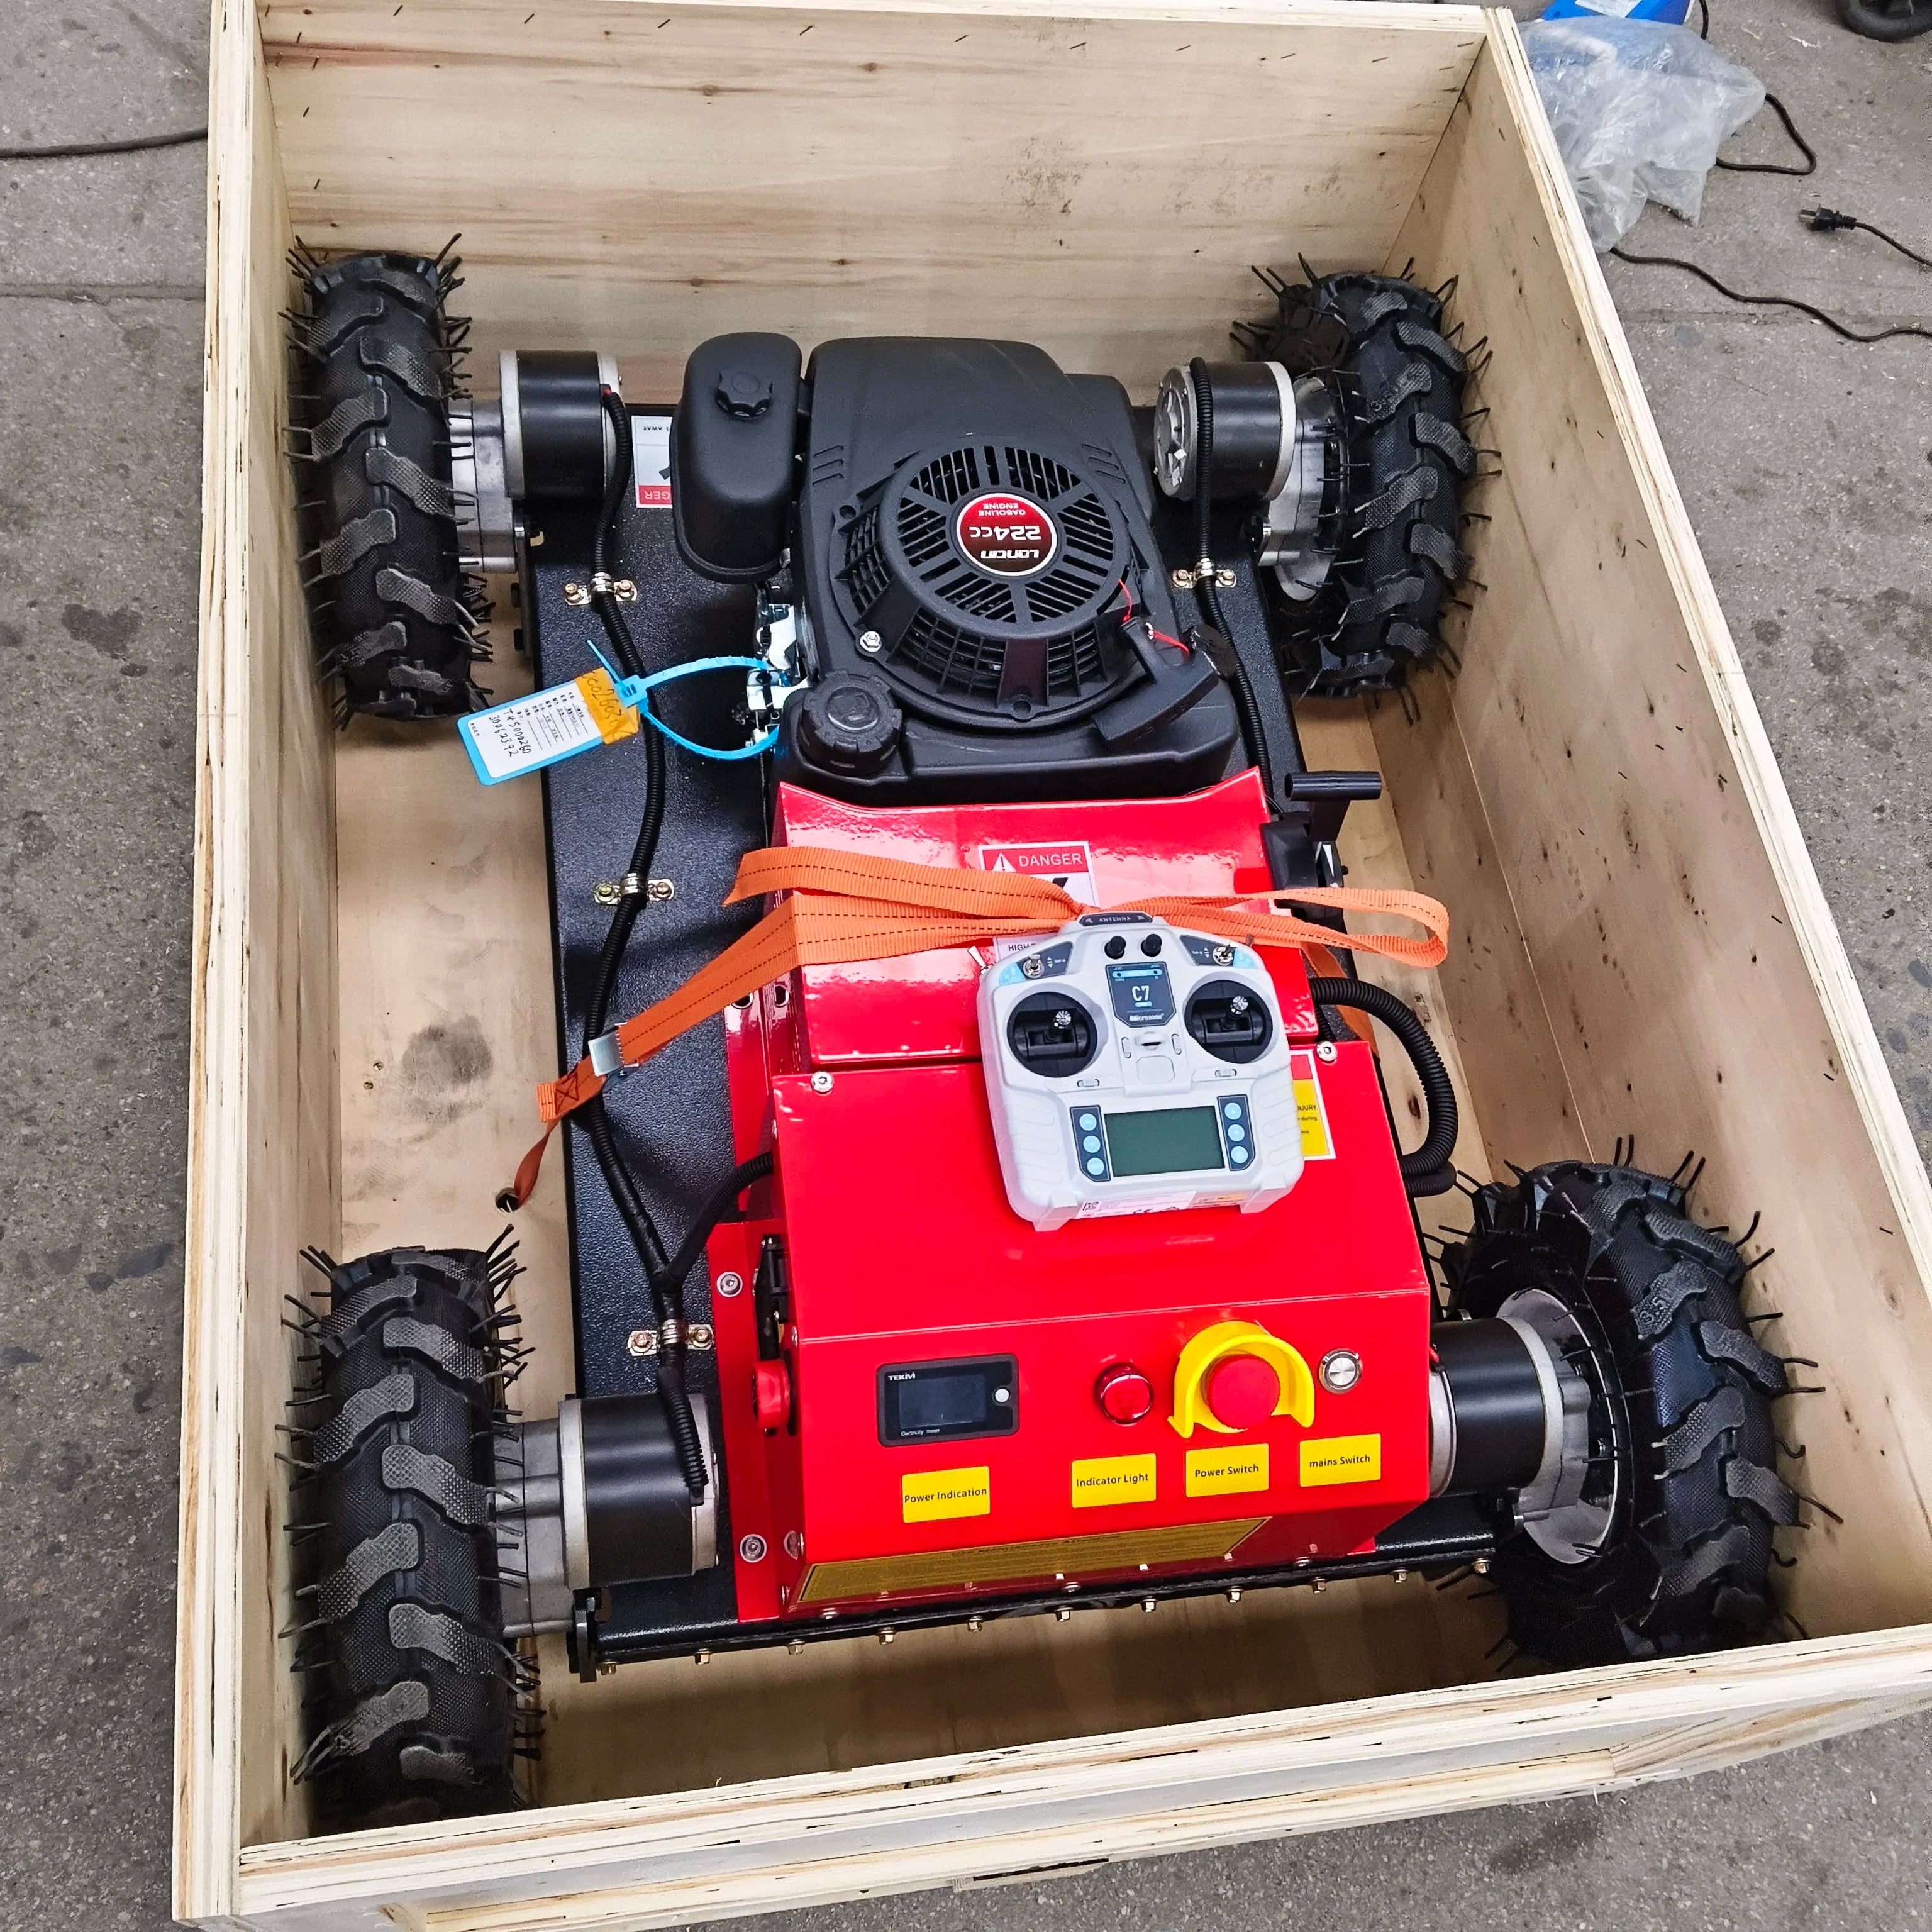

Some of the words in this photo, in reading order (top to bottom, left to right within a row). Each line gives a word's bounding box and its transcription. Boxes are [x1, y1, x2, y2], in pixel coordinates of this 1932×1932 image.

[644, 491, 670, 501] GER
[1018, 853, 1083, 868] DANGER
[1131, 985, 1150, 1001] C7
[1309, 1458, 1338, 1468] mains
[1340, 1453, 1370, 1465] Switch
[1194, 1468, 1225, 1478] Power
[1227, 1464, 1259, 1475] Switch
[1076, 1477, 1121, 1487] Indicator
[1124, 1473, 1148, 1484] Light
[904, 1494, 935, 1503] Power
[937, 1487, 987, 1500] Indication
